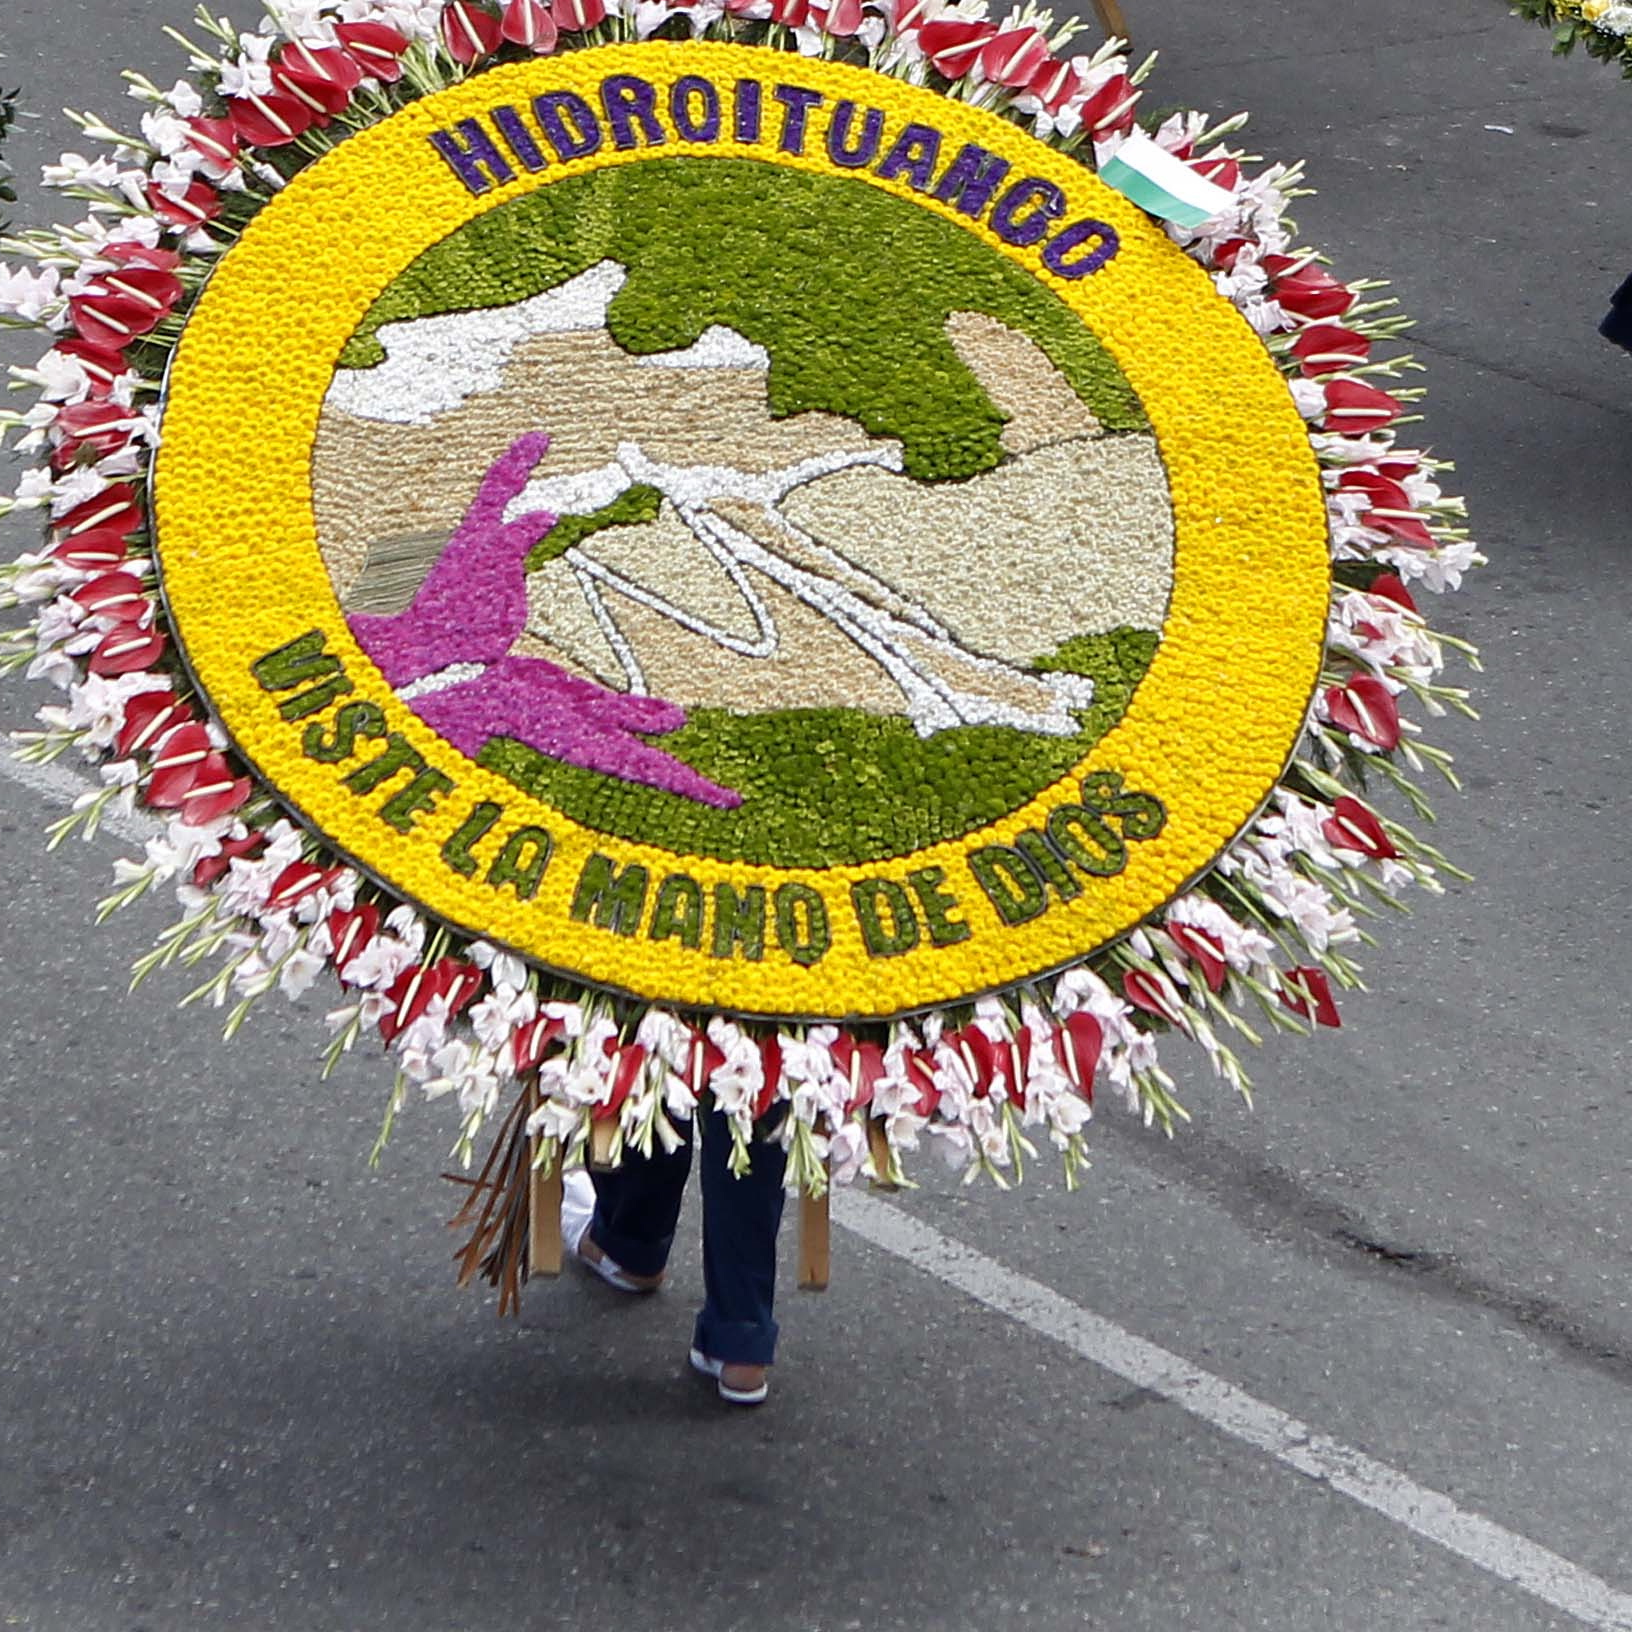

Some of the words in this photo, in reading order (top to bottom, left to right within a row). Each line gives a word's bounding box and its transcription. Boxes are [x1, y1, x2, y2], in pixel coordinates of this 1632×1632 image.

[250, 627, 459, 835] VISTE
[440, 800, 554, 902] LA
[570, 849, 832, 966] MANO
[850, 864, 973, 958] DE
[967, 769, 1169, 928] DIOS
